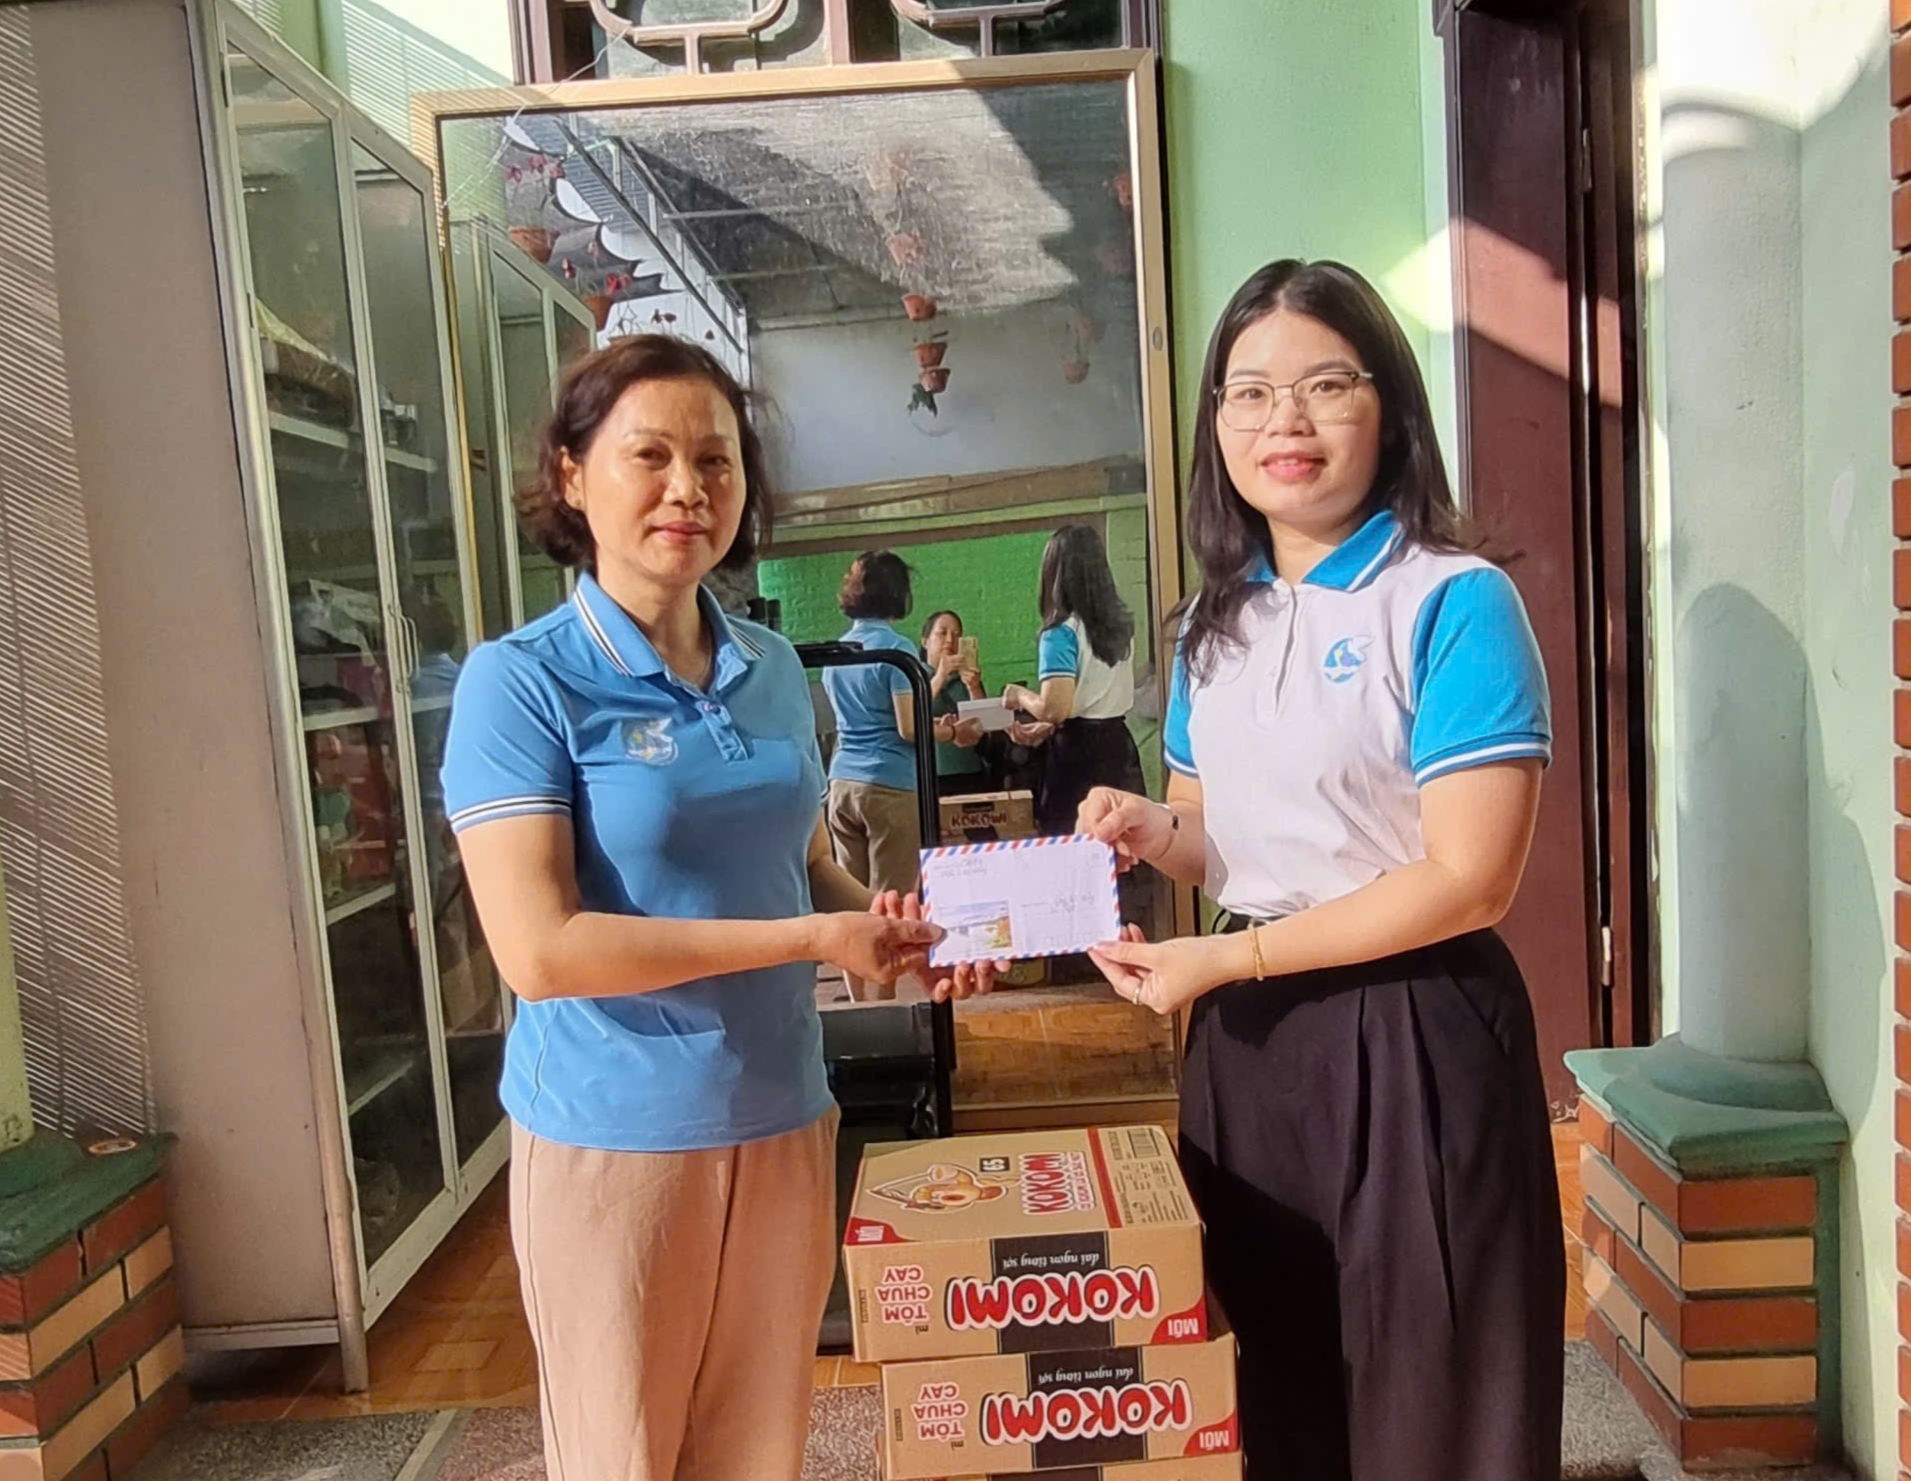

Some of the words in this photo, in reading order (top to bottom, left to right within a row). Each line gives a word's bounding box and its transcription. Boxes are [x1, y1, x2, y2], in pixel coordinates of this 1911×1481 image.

[982, 1158, 1005, 1171] 65
[1021, 1152, 1072, 1214] KOKOMI
[884, 1266, 922, 1282] CAY
[877, 1286, 931, 1302] CHUA
[947, 1266, 1159, 1330] KOKOMI
[884, 1305, 927, 1323] TÔM
[1168, 1317, 1199, 1338] MỚI
[920, 1384, 957, 1399] CAY
[913, 1402, 966, 1419] CHUA
[982, 1379, 1193, 1444] KOKOMI
[920, 1421, 962, 1439] TÔM
[1199, 1430, 1230, 1451] MỚI
